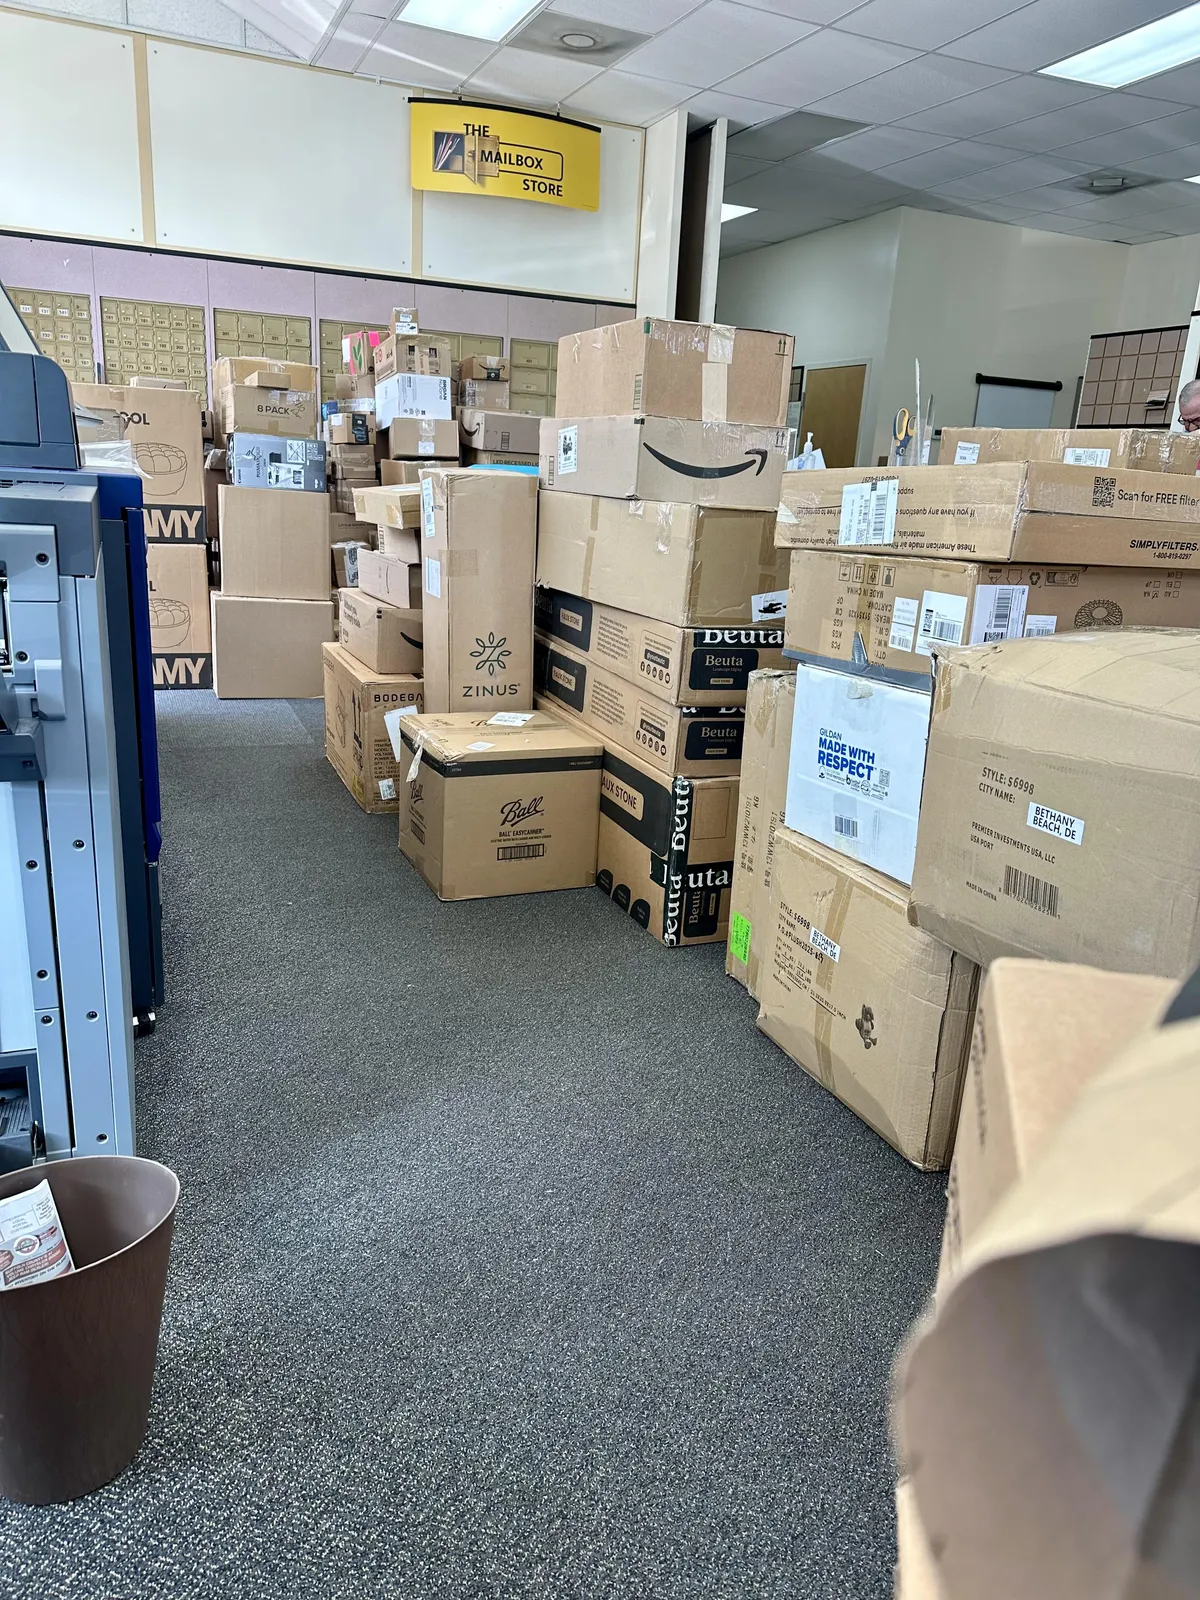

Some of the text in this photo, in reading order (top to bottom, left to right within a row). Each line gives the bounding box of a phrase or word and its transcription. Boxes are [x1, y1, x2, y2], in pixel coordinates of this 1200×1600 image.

[463, 123, 490, 138] THE
[480, 149, 543, 171] MAILBOX
[523, 178, 563, 197] STORE
[257, 404, 290, 415] 8 PACK
[1117, 489, 1139, 502] Scan
[1141, 491, 1154, 503] for
[1155, 492, 1178, 505] FREE
[899, 507, 927, 517] questions
[928, 507, 940, 517] any
[940, 508, 956, 517] have
[956, 507, 969, 517] you
[899, 541, 908, 550] air
[908, 541, 925, 550] made
[925, 541, 956, 551] American
[956, 543, 977, 553] These
[1153, 552, 1192, 560] 1-800-819-0297
[704, 654, 743, 667] Beuta
[374, 693, 424, 703] BODEGA
[462, 684, 518, 698] ZINUS
[700, 726, 738, 738] Beuta
[819, 727, 842, 742] GILDAN
[818, 737, 875, 765] MADE WITH
[817, 749, 874, 781] RESPECT
[981, 766, 1035, 796] STYLE: S6998
[602, 775, 638, 810] AUX STONE
[978, 782, 1016, 804] CITY NAME:
[499, 796, 545, 827] Ball
[1034, 806, 1076, 829] BETHANY
[1032, 817, 1077, 841] BEACH, DE
[970, 834, 994, 851] USA PORT
[971, 821, 1056, 865] PREMIER INVESTMENTS USA, LLC
[793, 912, 811, 930] S6998
[813, 930, 837, 950] BETHANY
[829, 950, 838, 960] DE
